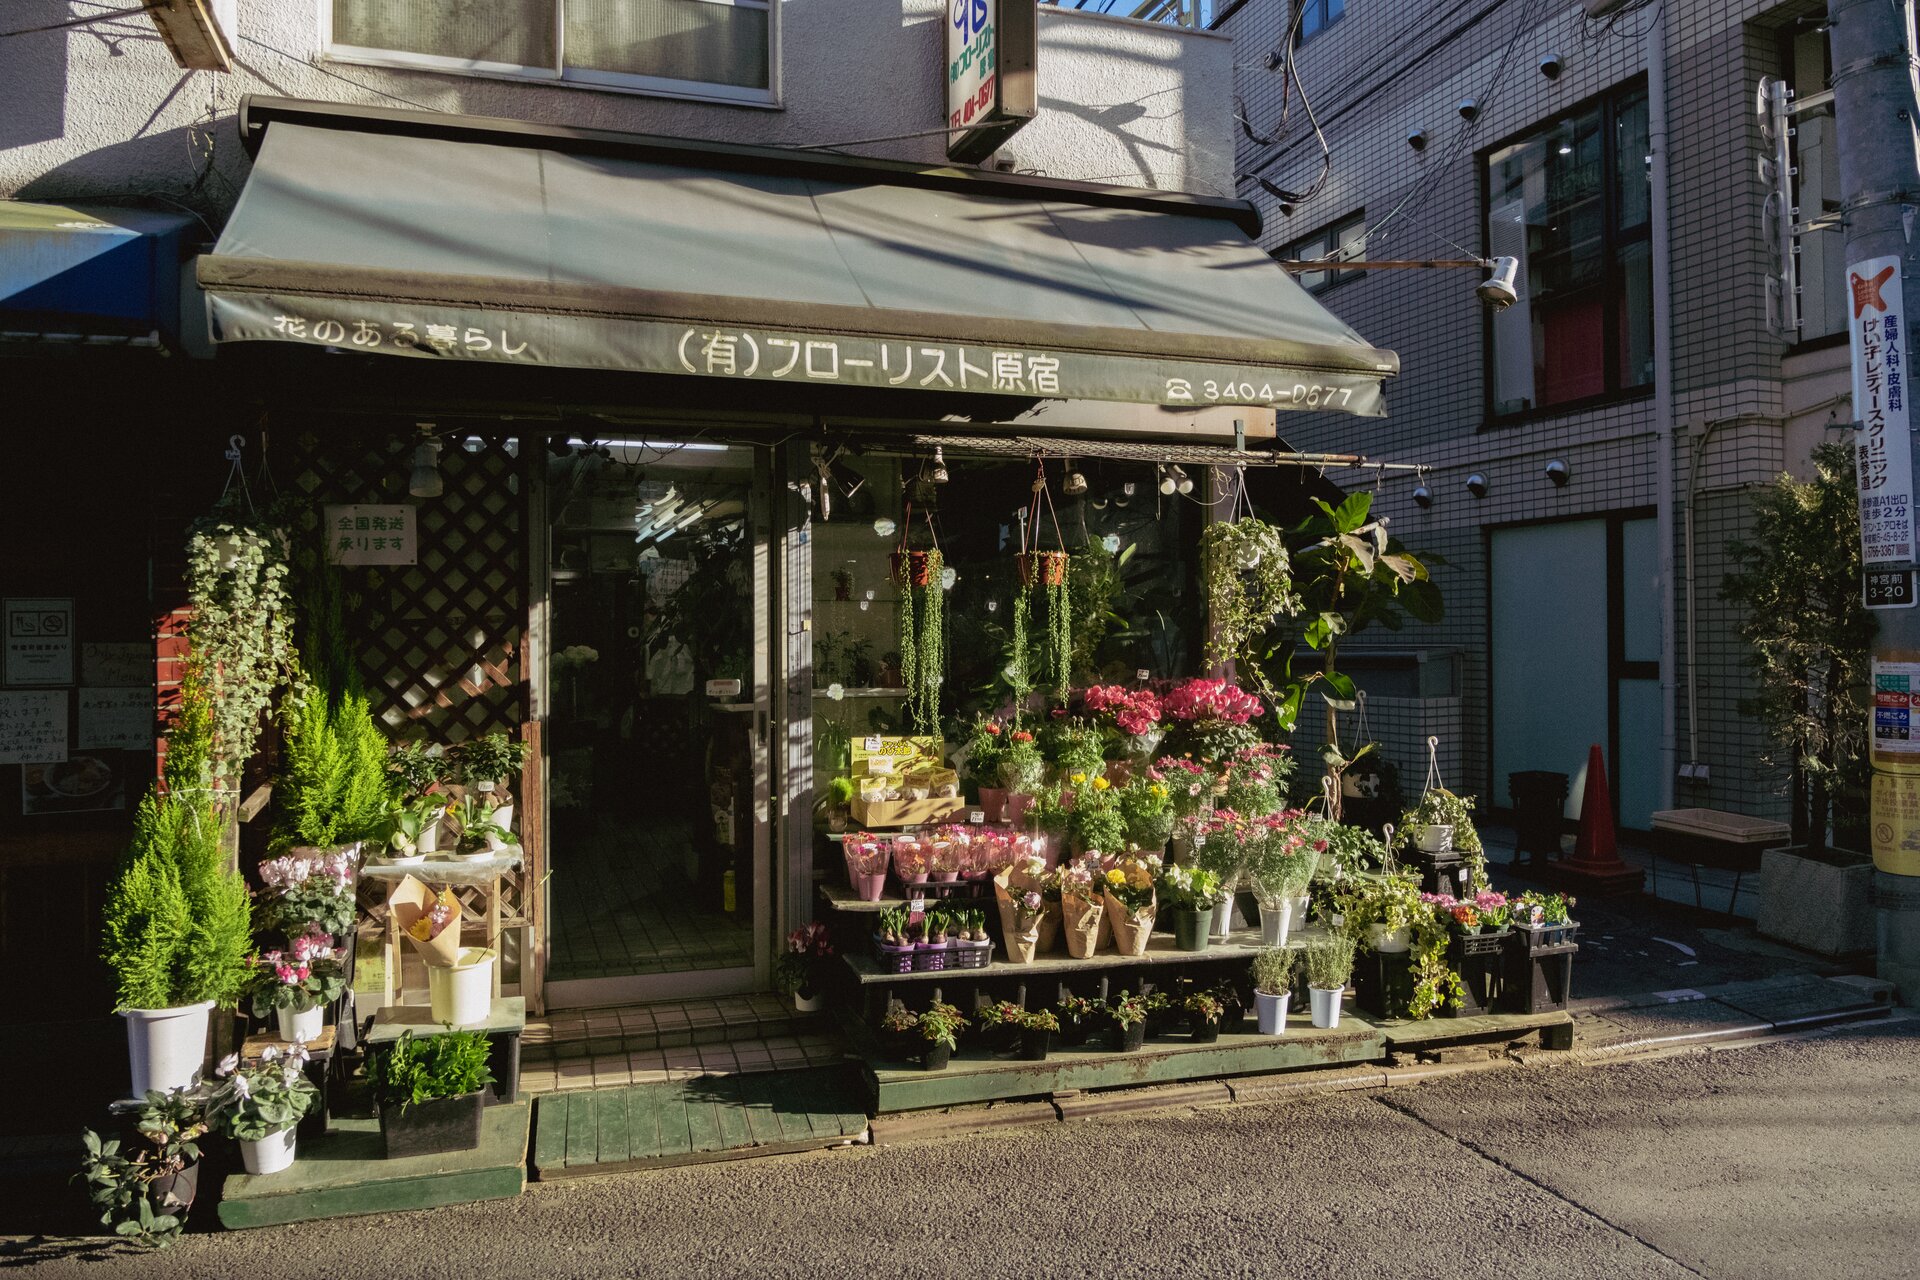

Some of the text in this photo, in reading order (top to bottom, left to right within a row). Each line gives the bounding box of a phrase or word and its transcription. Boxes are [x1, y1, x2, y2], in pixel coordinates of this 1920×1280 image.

[273, 314, 528, 355] 花のある暮らし
[1884, 314, 1902, 412] 産婦人科・皮膚科
[1203, 379, 1353, 406] 3404-0677
[1863, 319, 1887, 489] けい子レディースクリニック
[1859, 445, 1871, 490] 表参道
[338, 516, 404, 531] 全国発送
[338, 536, 404, 551] 承ります
[1870, 573, 1903, 585] 神宮前
[1870, 585, 1904, 598] 3-20
